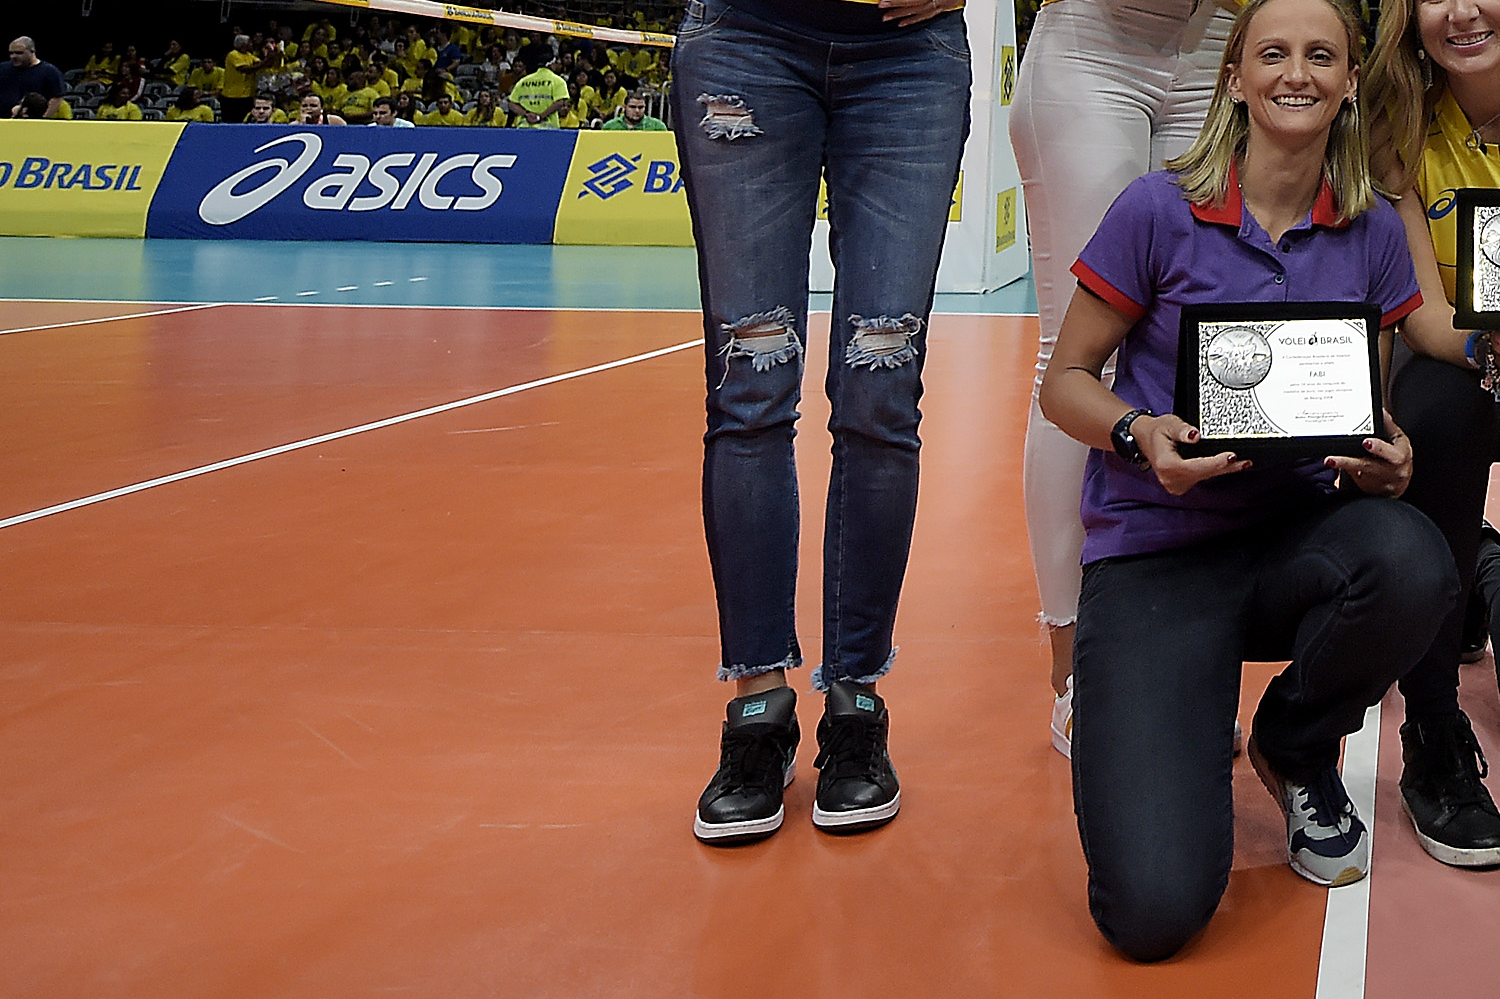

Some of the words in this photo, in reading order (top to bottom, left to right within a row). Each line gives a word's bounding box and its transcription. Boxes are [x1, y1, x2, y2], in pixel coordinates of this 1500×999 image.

[14, 157, 142, 190] BRASIL
[1320, 335, 1353, 345] BRASIL
[1309, 370, 1326, 378] FABI
